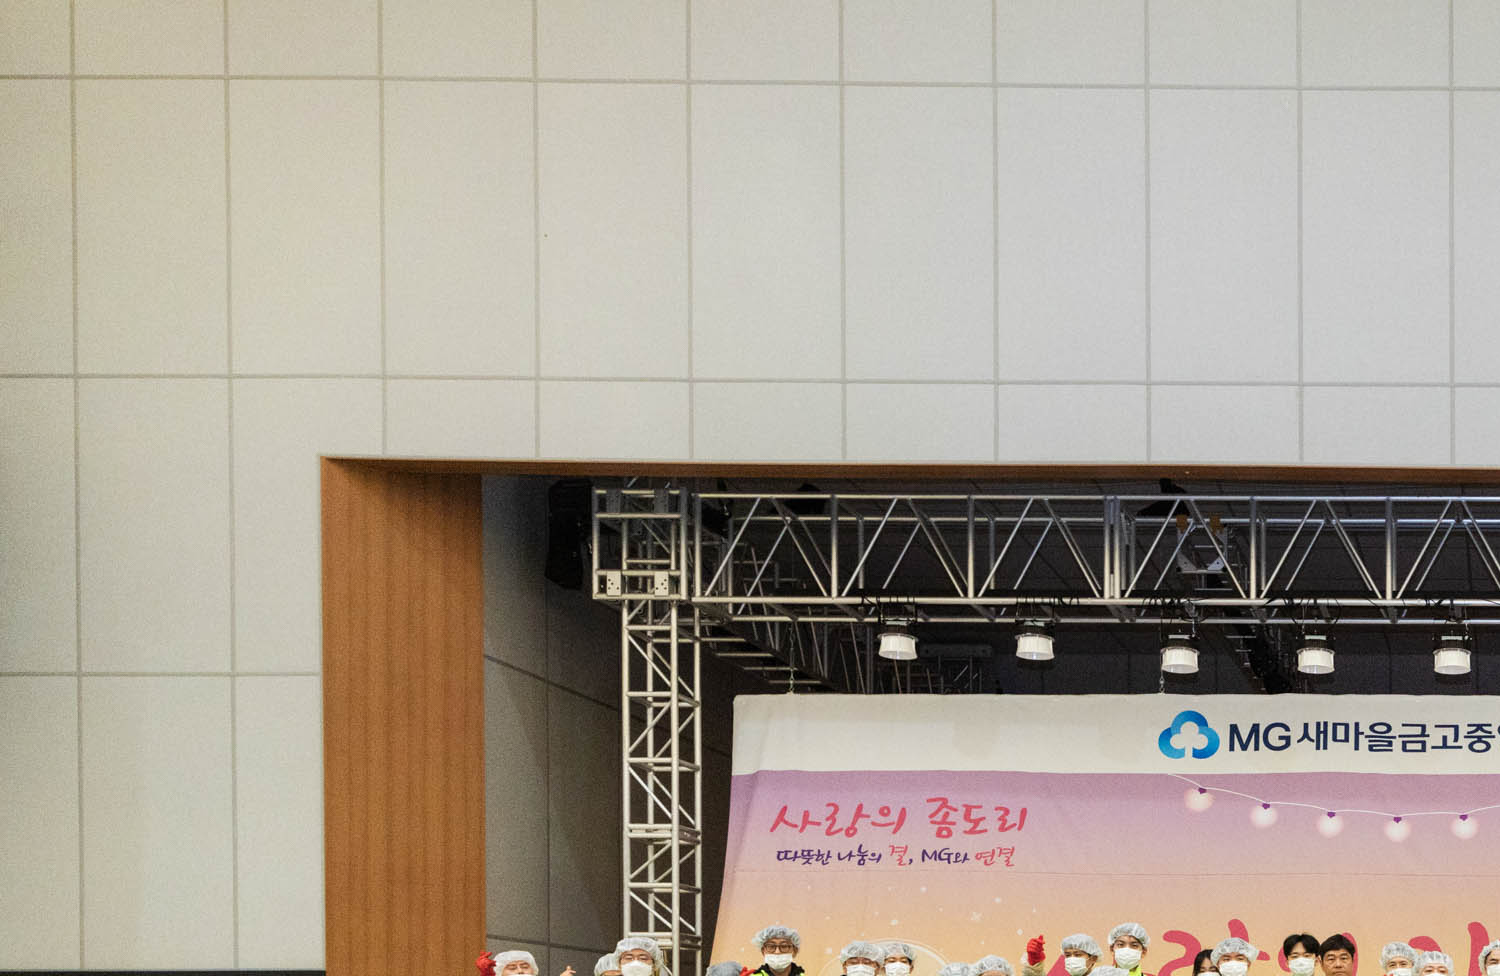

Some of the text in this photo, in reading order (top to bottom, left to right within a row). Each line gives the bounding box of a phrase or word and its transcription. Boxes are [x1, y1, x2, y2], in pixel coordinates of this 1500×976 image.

[769, 801, 908, 839] 사랑의
[776, 848, 833, 866] 따뜻한
[837, 843, 883, 867] 나눔의
[921, 847, 971, 866] MG와
[974, 846, 1016, 868] 연결
